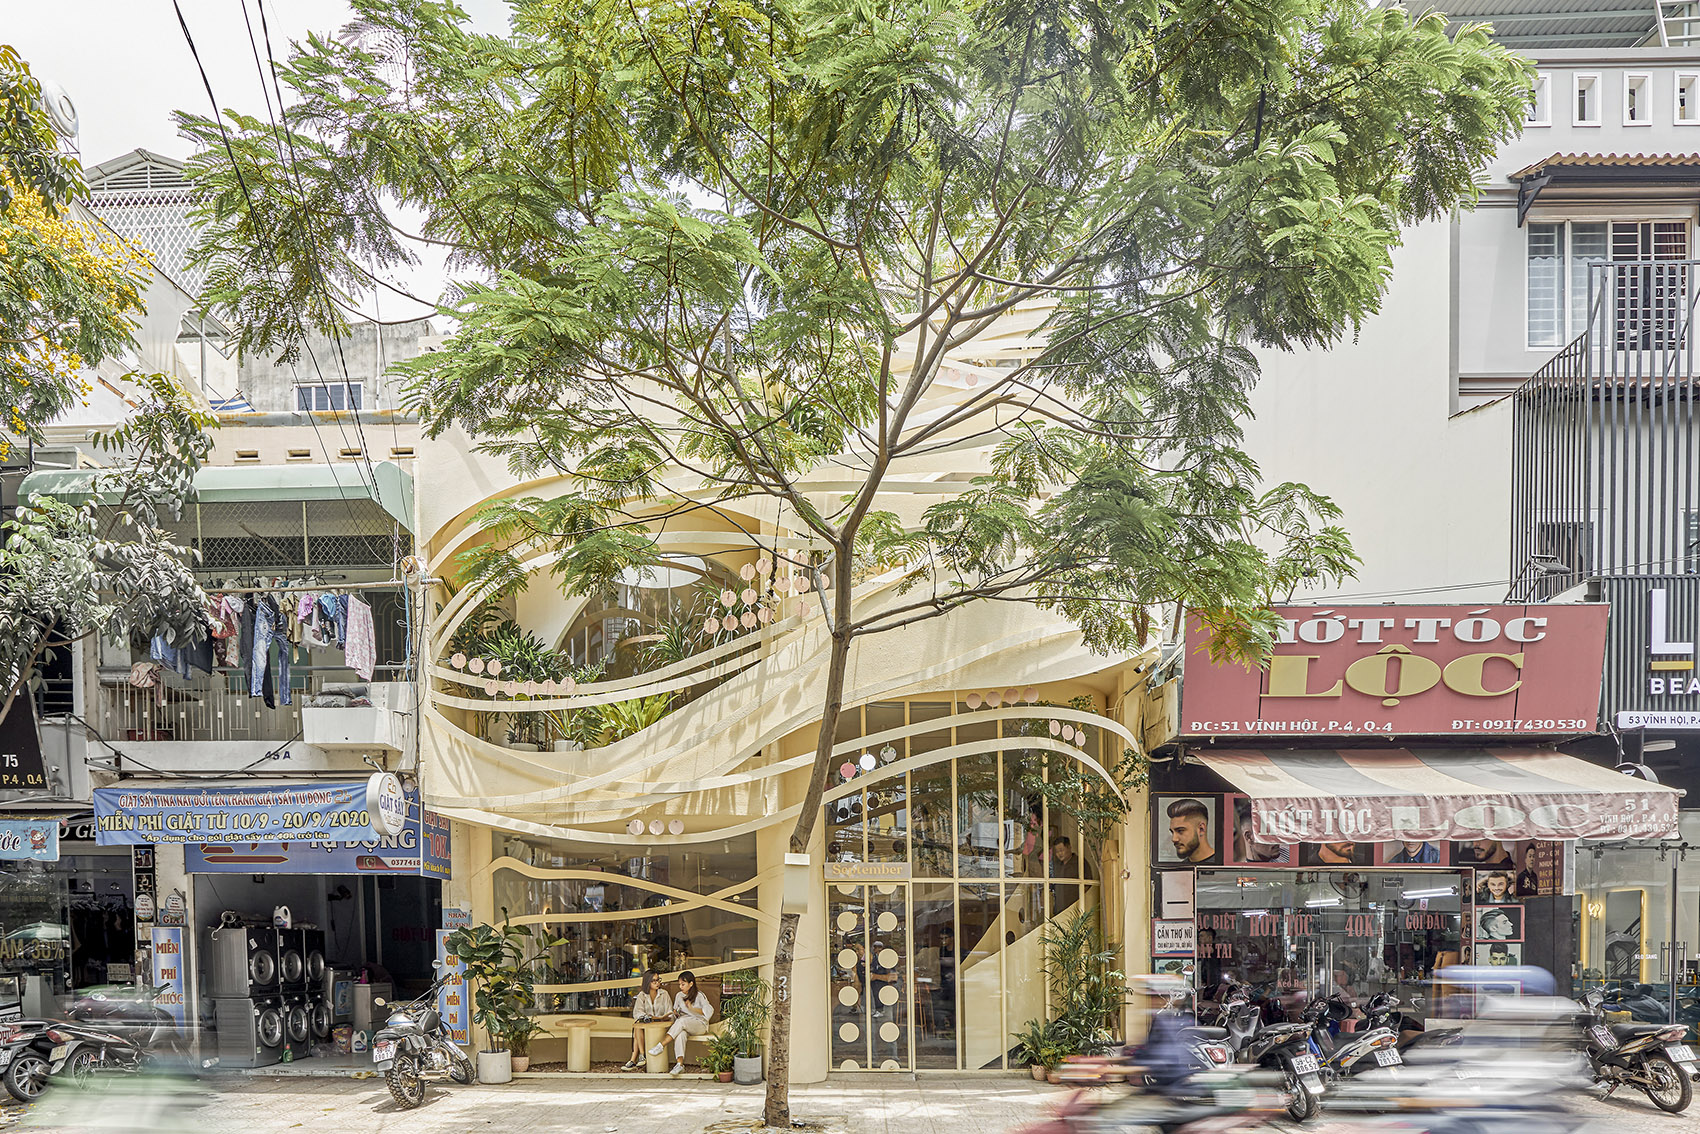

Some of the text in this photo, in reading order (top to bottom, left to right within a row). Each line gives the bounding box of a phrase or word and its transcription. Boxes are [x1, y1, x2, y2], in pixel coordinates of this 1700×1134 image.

[1405, 608, 1548, 643] TÓC
[1260, 644, 1525, 707] LỘC
[1245, 718, 1287, 732] VĨNH
[1628, 716, 1641, 724] 53
[2, 754, 19, 768] 75
[97, 809, 135, 832] MIỄN
[137, 811, 164, 832] PHÍ
[206, 810, 230, 830] TỪ
[232, 812, 270, 830] 10/9
[282, 810, 370, 829] 20/9/2020
[1258, 799, 1590, 836] HỚT TÓC LỘC
[188, 833, 206, 842] cho
[314, 831, 330, 840] lên
[831, 862, 904, 877] September
[1284, 909, 1313, 937] TÓC
[1344, 915, 1375, 937] 40K
